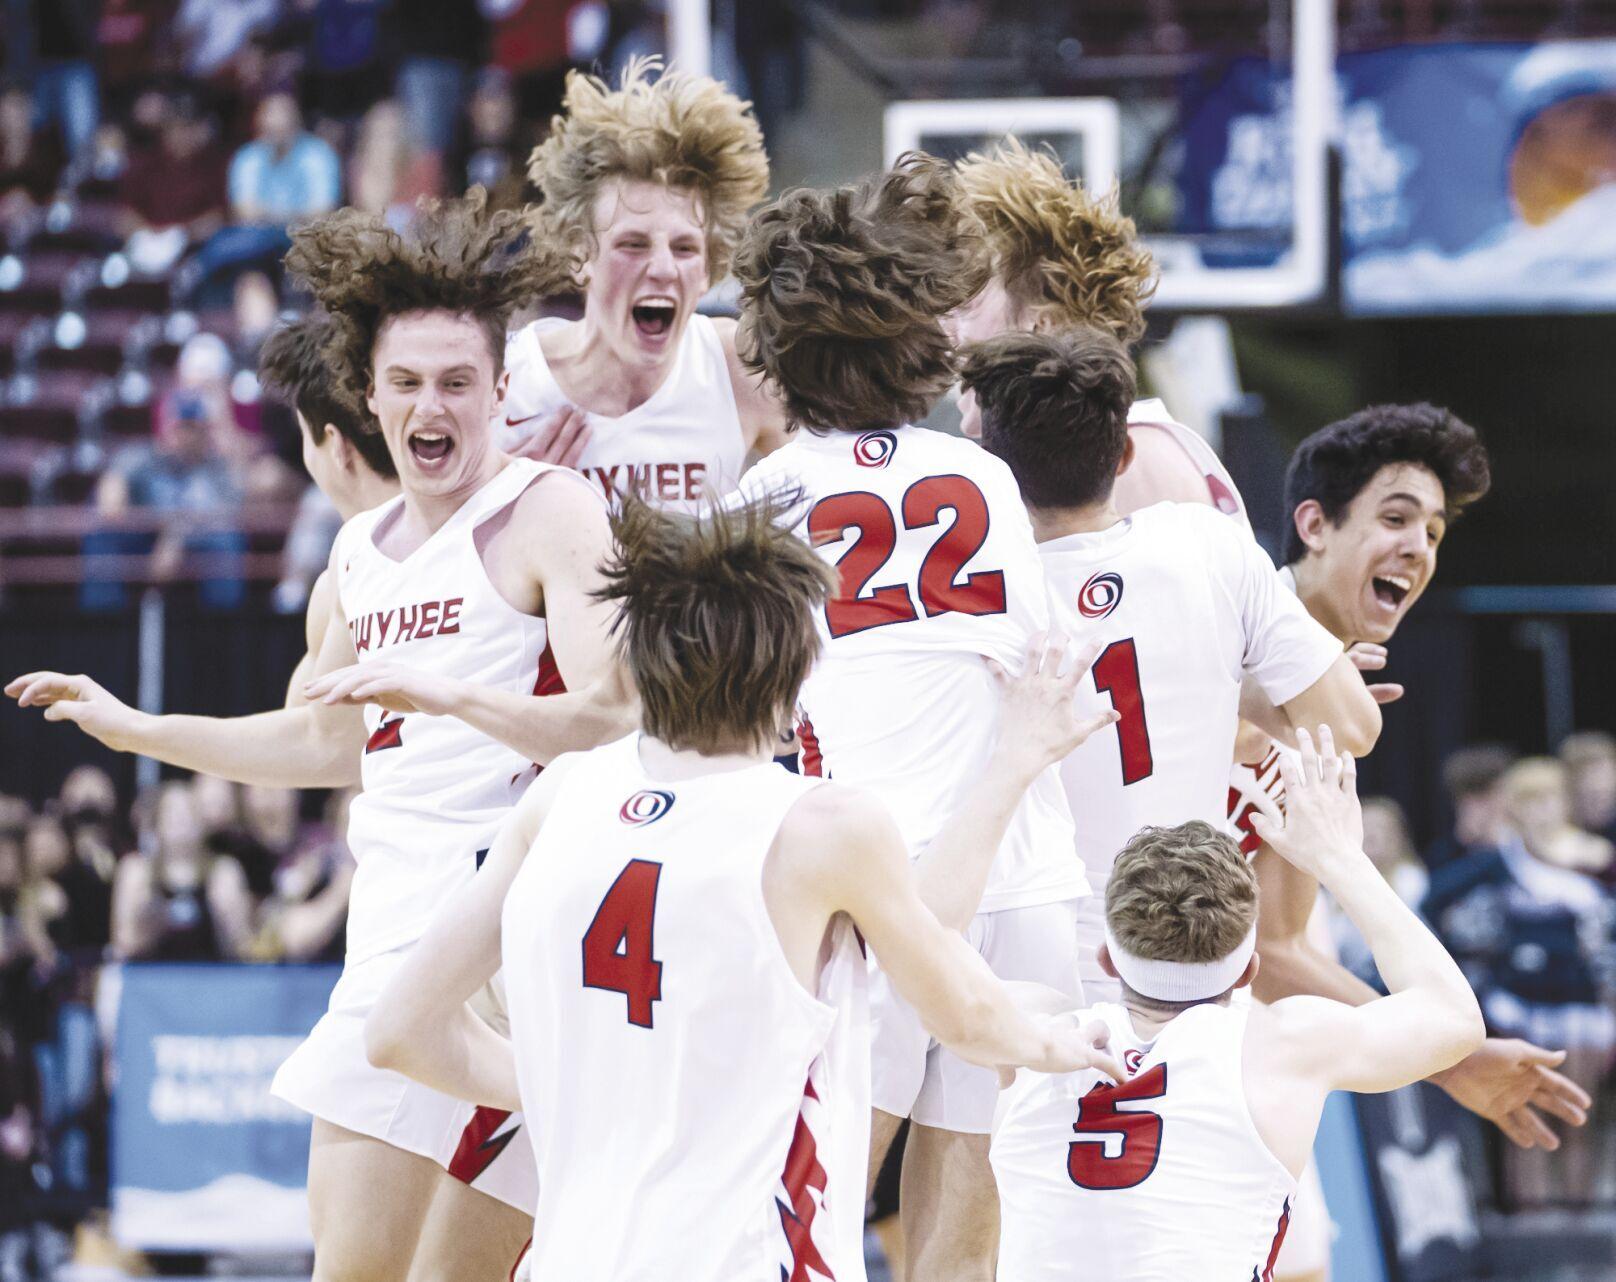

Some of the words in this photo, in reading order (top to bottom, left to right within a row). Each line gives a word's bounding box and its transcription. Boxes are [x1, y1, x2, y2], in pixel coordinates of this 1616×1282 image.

[582, 463, 706, 501] YHEE
[348, 597, 464, 655] WYHEE
[807, 473, 1007, 640] 22
[1091, 637, 1154, 786] 1
[581, 857, 663, 1030] 4
[1066, 1061, 1168, 1191] 5
